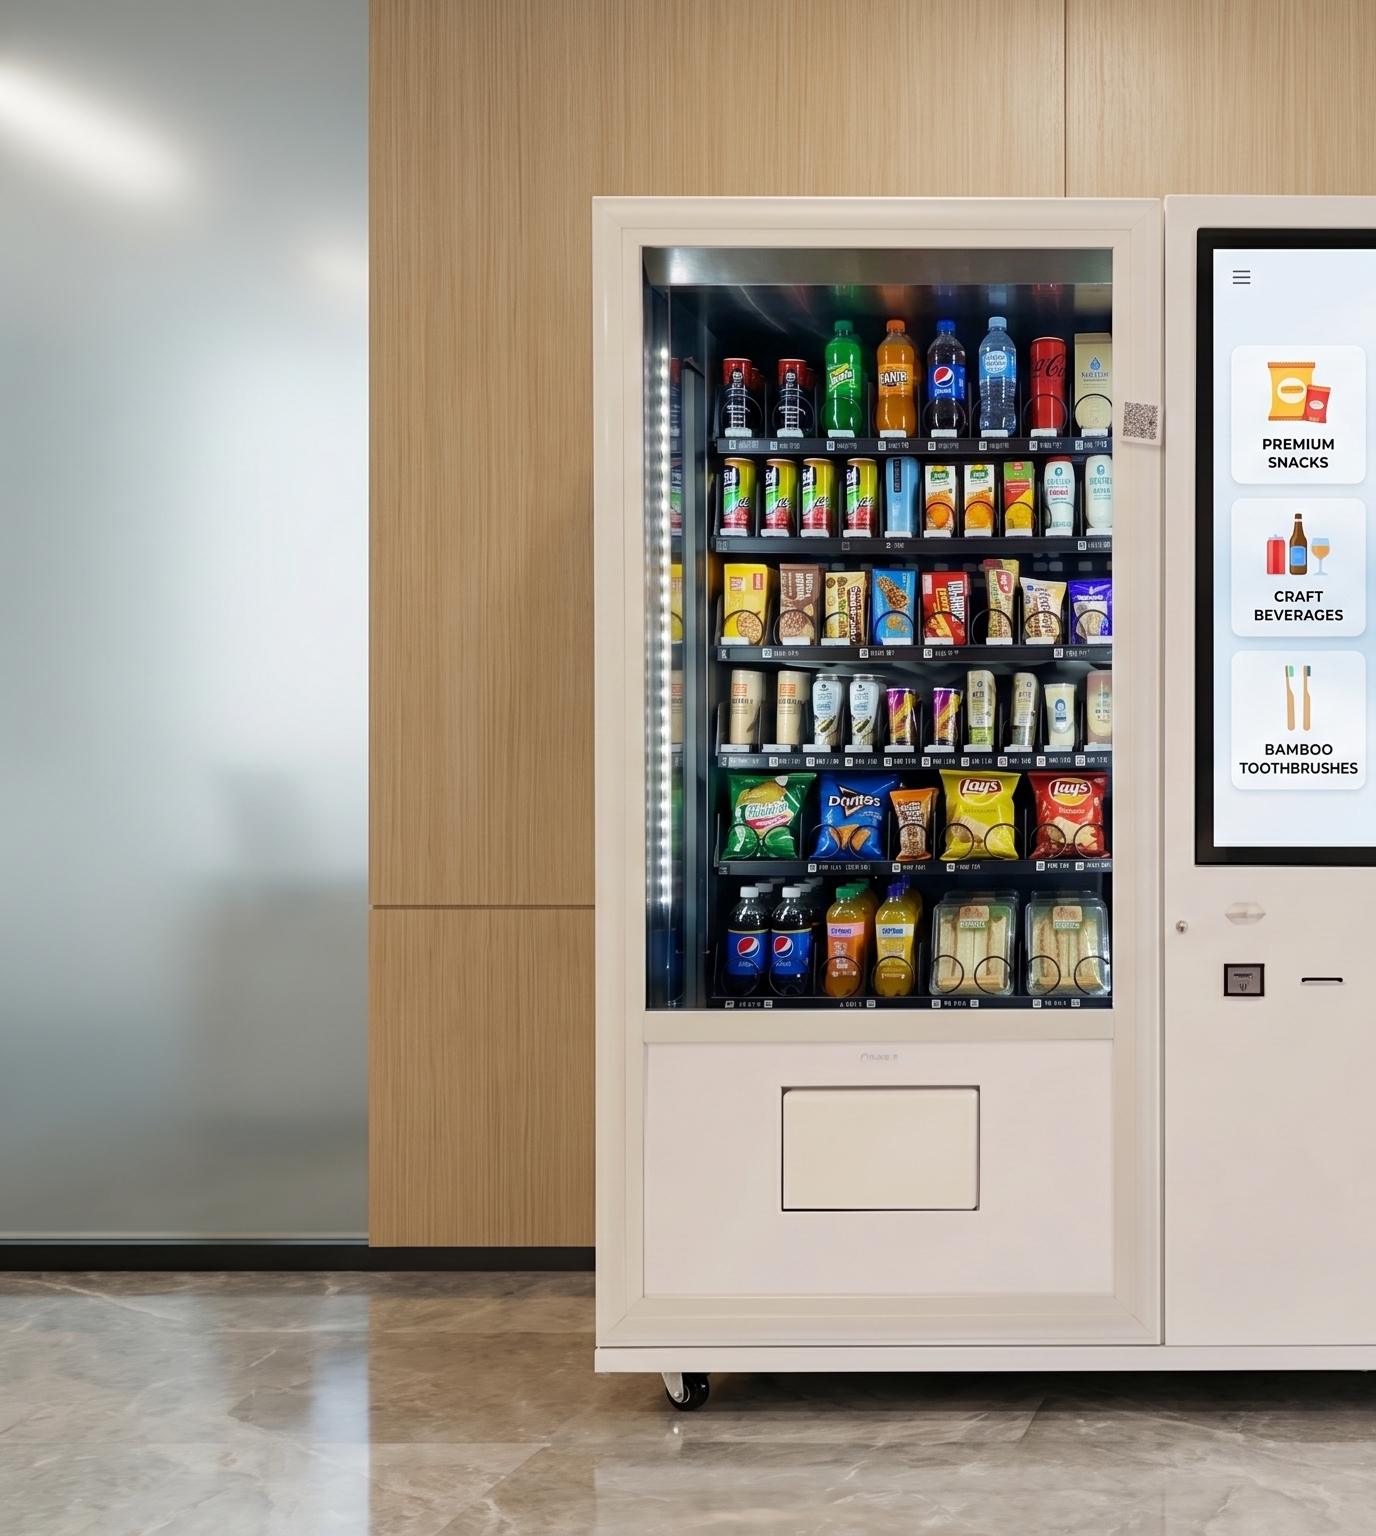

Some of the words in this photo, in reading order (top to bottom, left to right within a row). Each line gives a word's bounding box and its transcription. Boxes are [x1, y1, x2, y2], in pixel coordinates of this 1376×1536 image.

[1262, 438, 1335, 451] PREMIUM
[1268, 456, 1329, 469] SNACKS
[1274, 590, 1324, 603] CRAFT
[1254, 609, 1344, 622] BEVERAGES
[1265, 743, 1333, 756] BAMBOO
[1238, 762, 1359, 775] TOOTHBRUSHES
